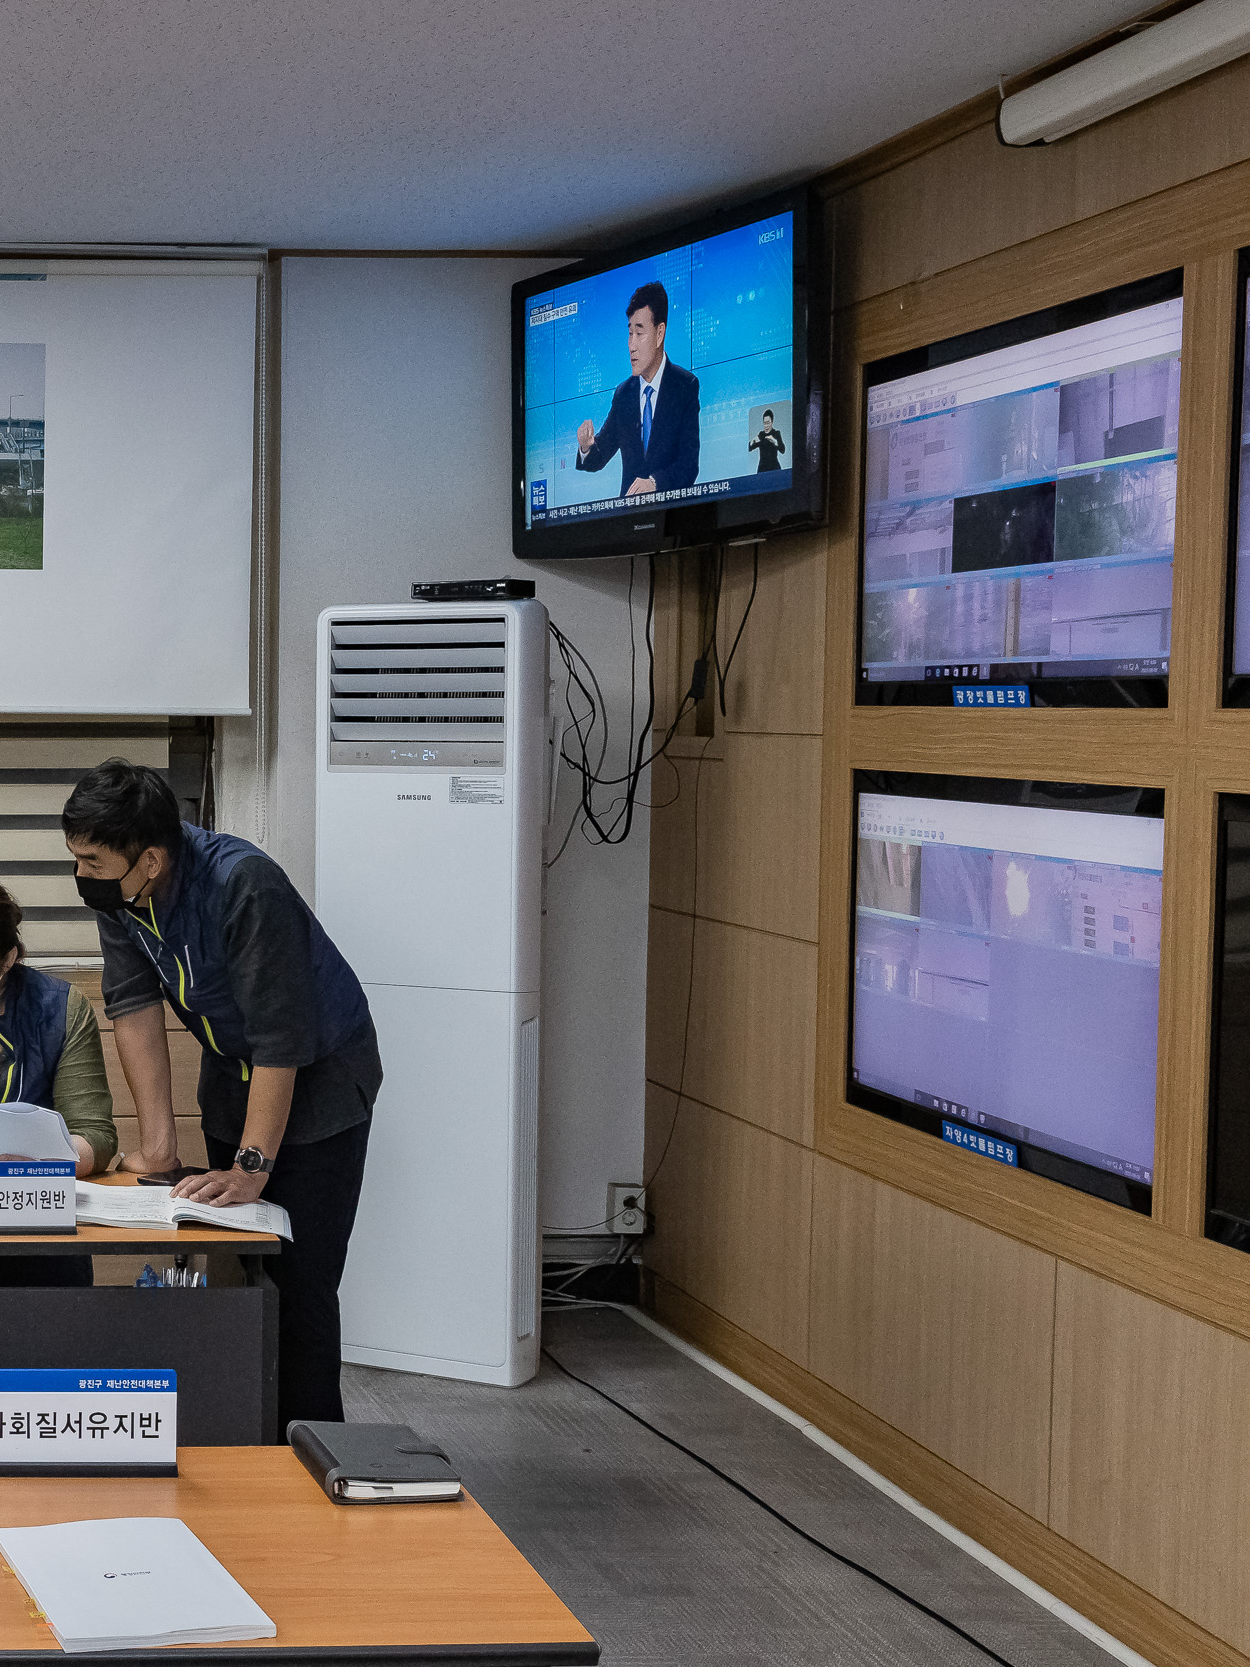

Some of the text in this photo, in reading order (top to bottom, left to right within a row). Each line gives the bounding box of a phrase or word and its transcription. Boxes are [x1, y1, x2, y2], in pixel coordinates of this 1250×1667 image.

[532, 484, 545, 495] 뉴스
[687, 485, 702, 496] 보내실
[702, 485, 708, 495] 수
[708, 481, 731, 493] 있습니다.
[956, 690, 1026, 704] 광장빗물펌프장
[422, 749, 436, 761] 24
[945, 1125, 1014, 1163] 자양4빗물펌프장
[7, 1167, 71, 1175] 광진구 재난안전대책본부
[78, 1379, 170, 1389] 광진구 재난안전대책본부
